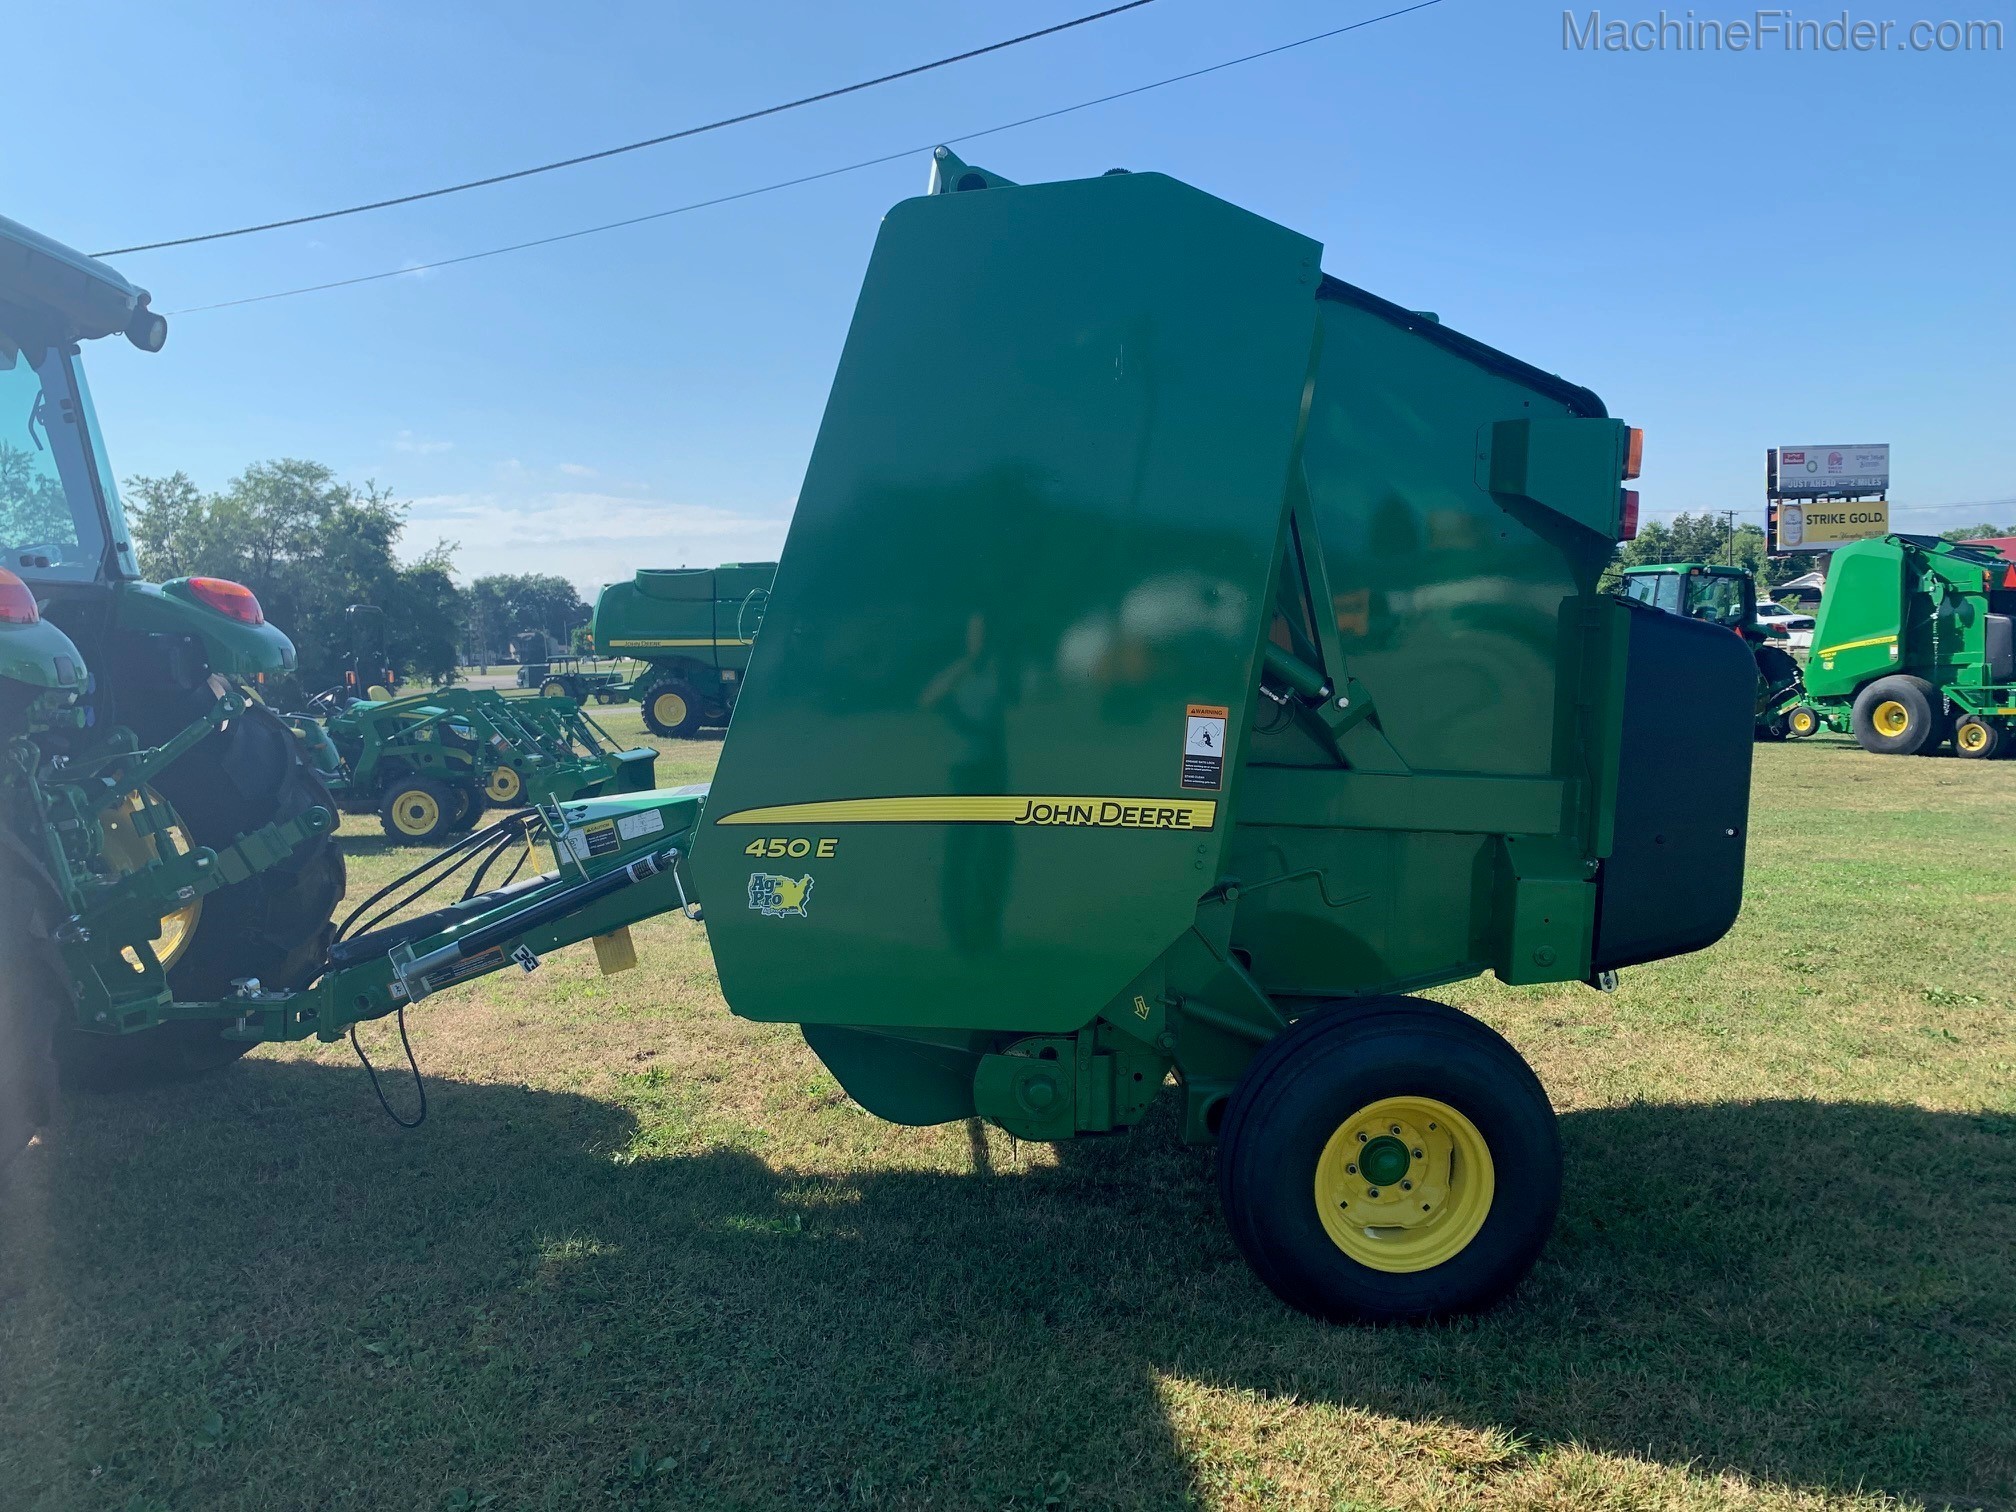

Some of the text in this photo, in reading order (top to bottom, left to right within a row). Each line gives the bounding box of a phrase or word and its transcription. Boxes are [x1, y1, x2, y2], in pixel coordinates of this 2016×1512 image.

[1788, 480, 1808, 488] JUST
[1809, 479, 1836, 487] AHEAD
[1856, 478, 1882, 486] MILES
[1806, 513, 1846, 525] STRIKE
[1849, 512, 1885, 524] GOLD.
[1195, 708, 1223, 716] WARNING
[1014, 800, 1193, 827] JOHN DEERE
[744, 837, 840, 859] 450 E
[751, 891, 783, 906] Pro
